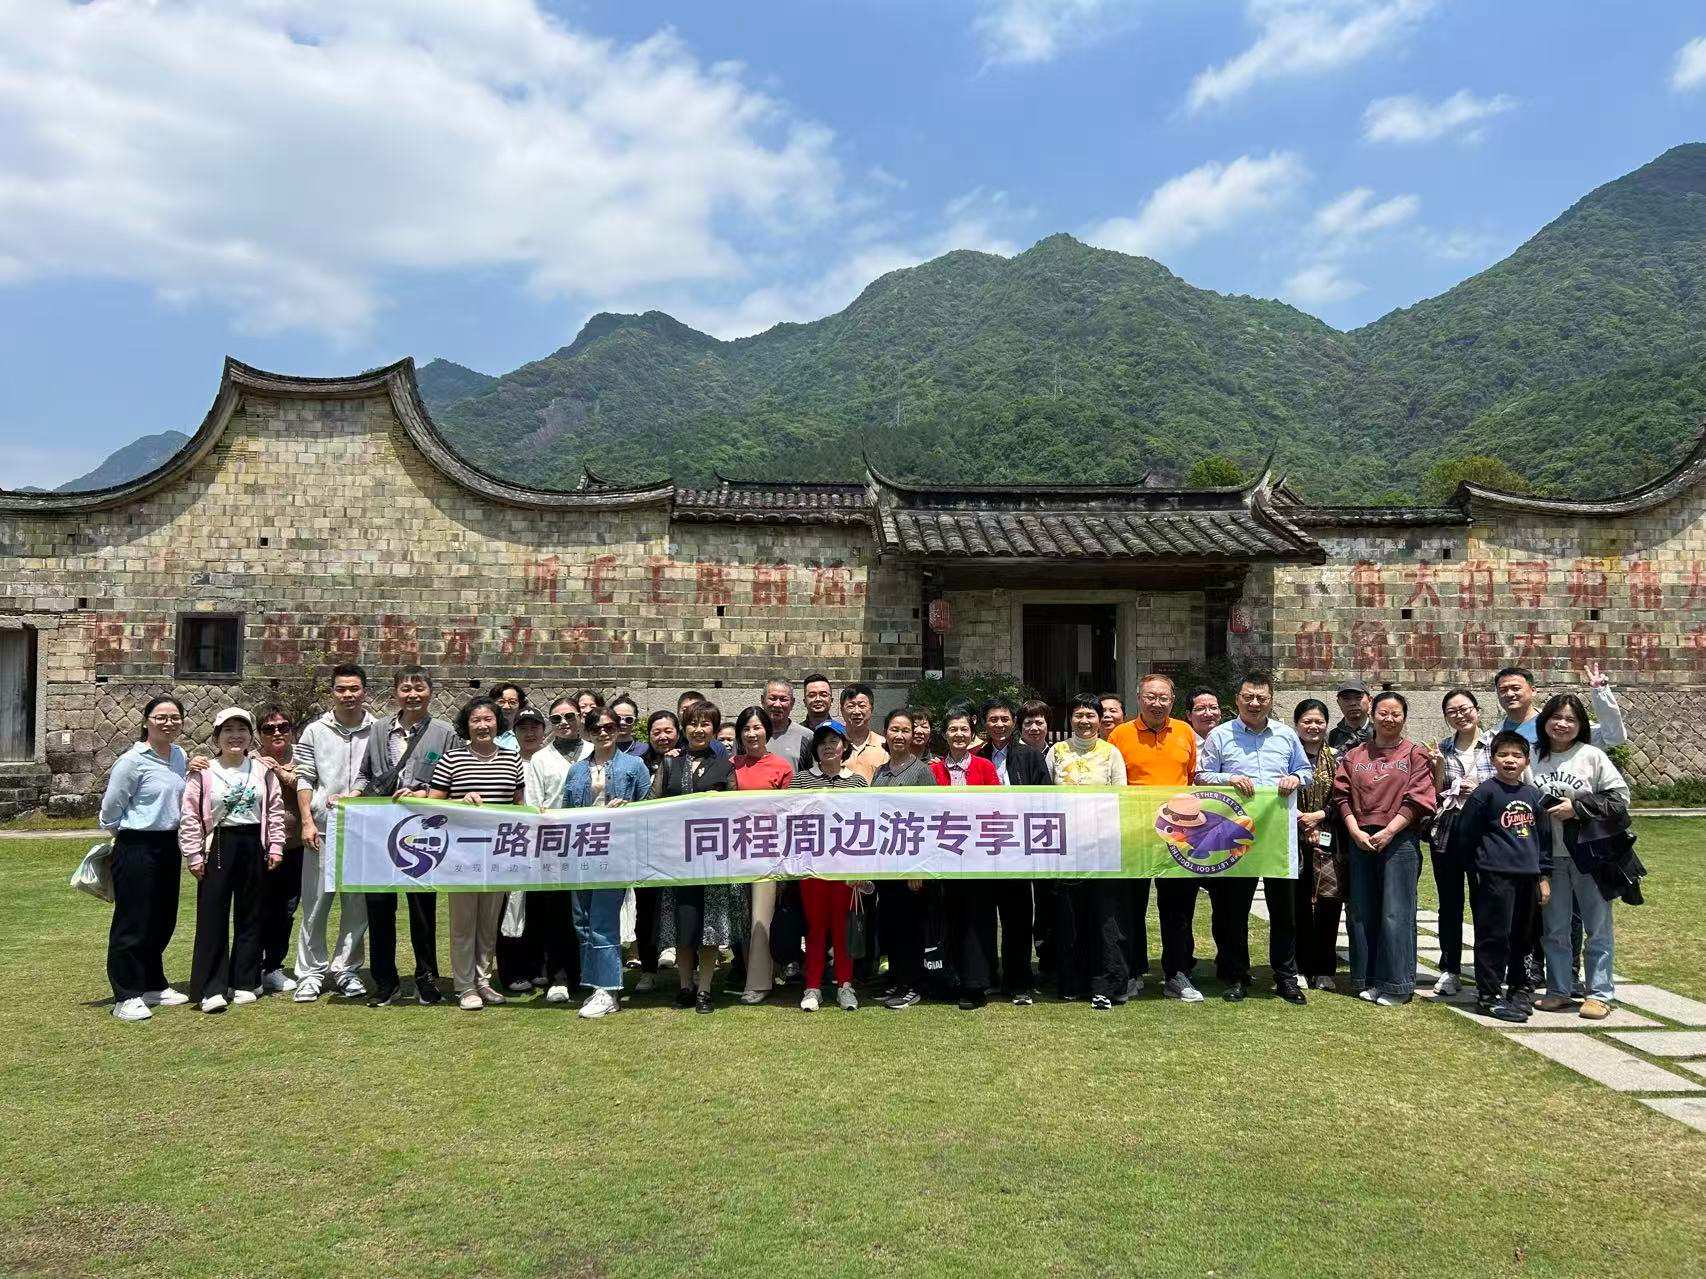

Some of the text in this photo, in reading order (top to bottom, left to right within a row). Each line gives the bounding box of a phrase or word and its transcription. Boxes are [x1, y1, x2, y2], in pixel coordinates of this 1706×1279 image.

[1533, 771, 1583, 790] LI-NING
[456, 821, 612, 858] 一路同程
[684, 810, 1068, 862] 同程周边游专享团
